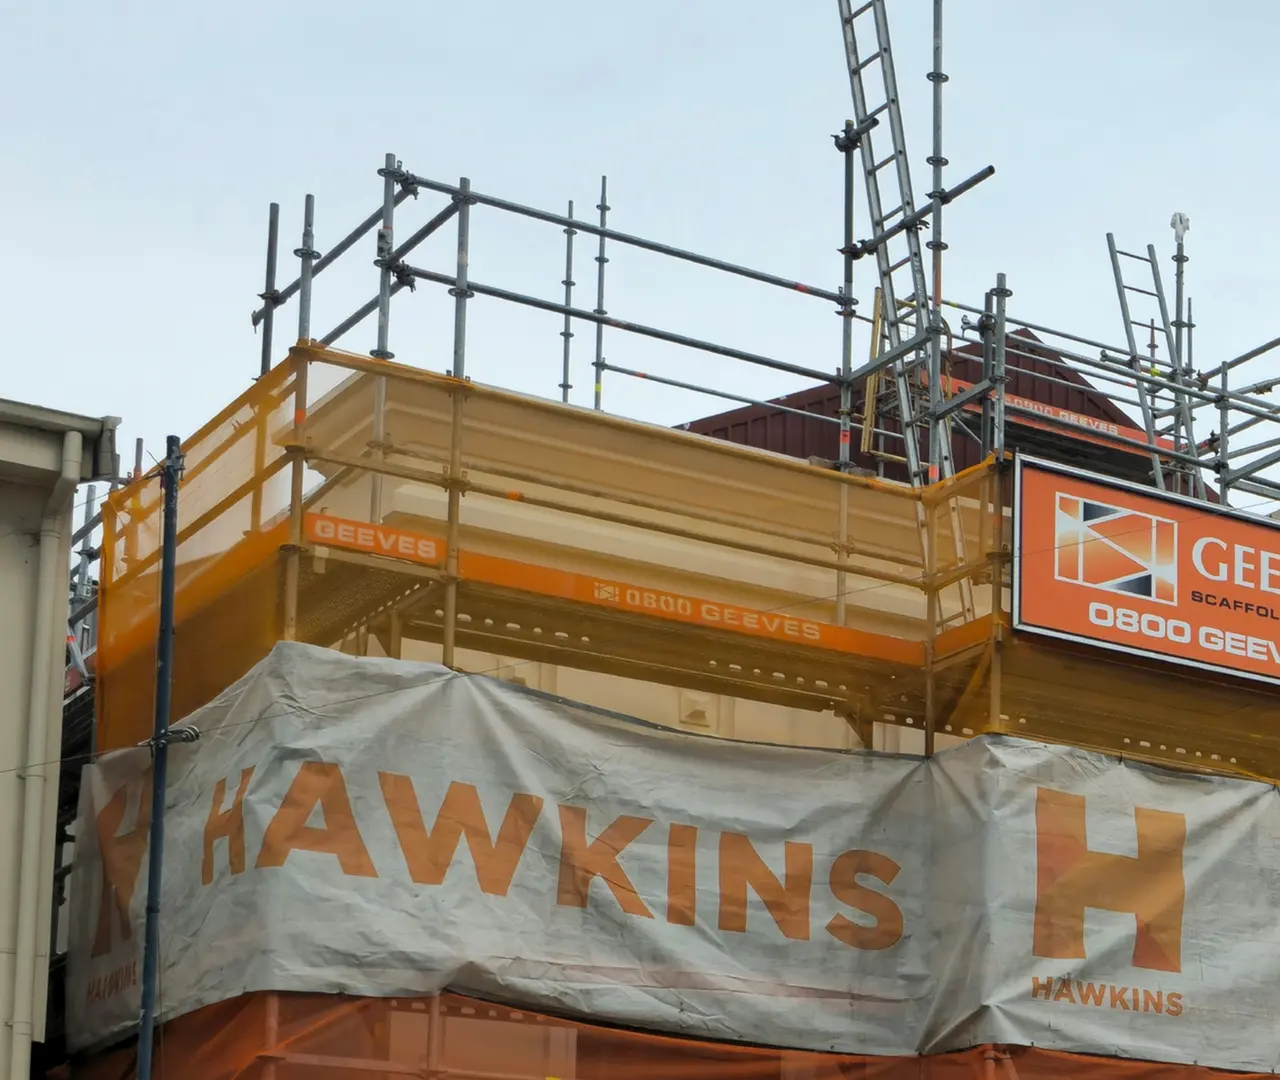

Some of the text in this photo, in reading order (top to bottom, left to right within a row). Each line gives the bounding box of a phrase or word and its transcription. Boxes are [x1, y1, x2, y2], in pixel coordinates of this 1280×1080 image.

[1059, 410, 1119, 436] GEEVES
[313, 518, 437, 560] GEEVES
[625, 589, 822, 641] 0800 GEEVES
[1088, 601, 1192, 644] 0800
[201, 760, 904, 951] HAWKINS
[1032, 786, 1187, 973] H
[1031, 975, 1184, 1018] HAWKINS
